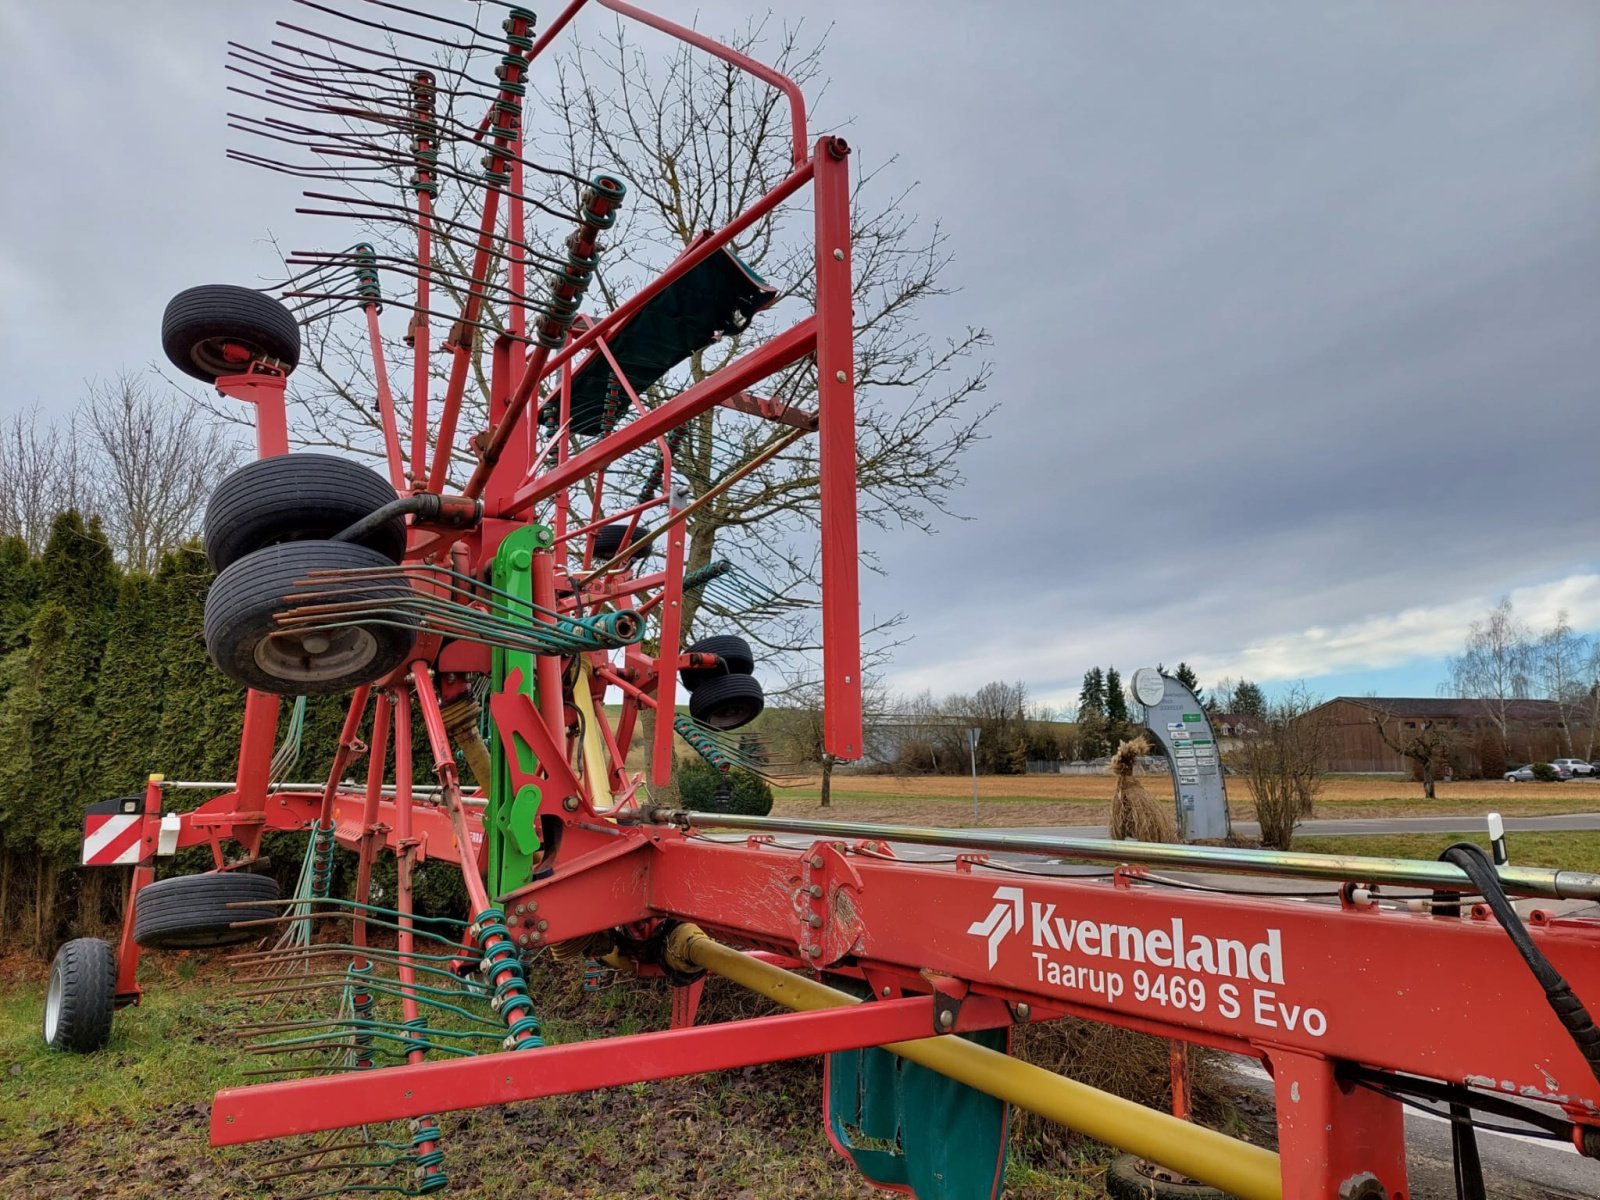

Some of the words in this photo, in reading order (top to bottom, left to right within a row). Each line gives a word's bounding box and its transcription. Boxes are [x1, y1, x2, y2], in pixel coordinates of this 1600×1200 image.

[1031, 902, 1285, 984] Kverneland
[1032, 952, 1123, 1002] Taarup
[1134, 970, 1206, 1012] 9469
[1218, 984, 1241, 1019] S
[1253, 989, 1327, 1037] Evo
